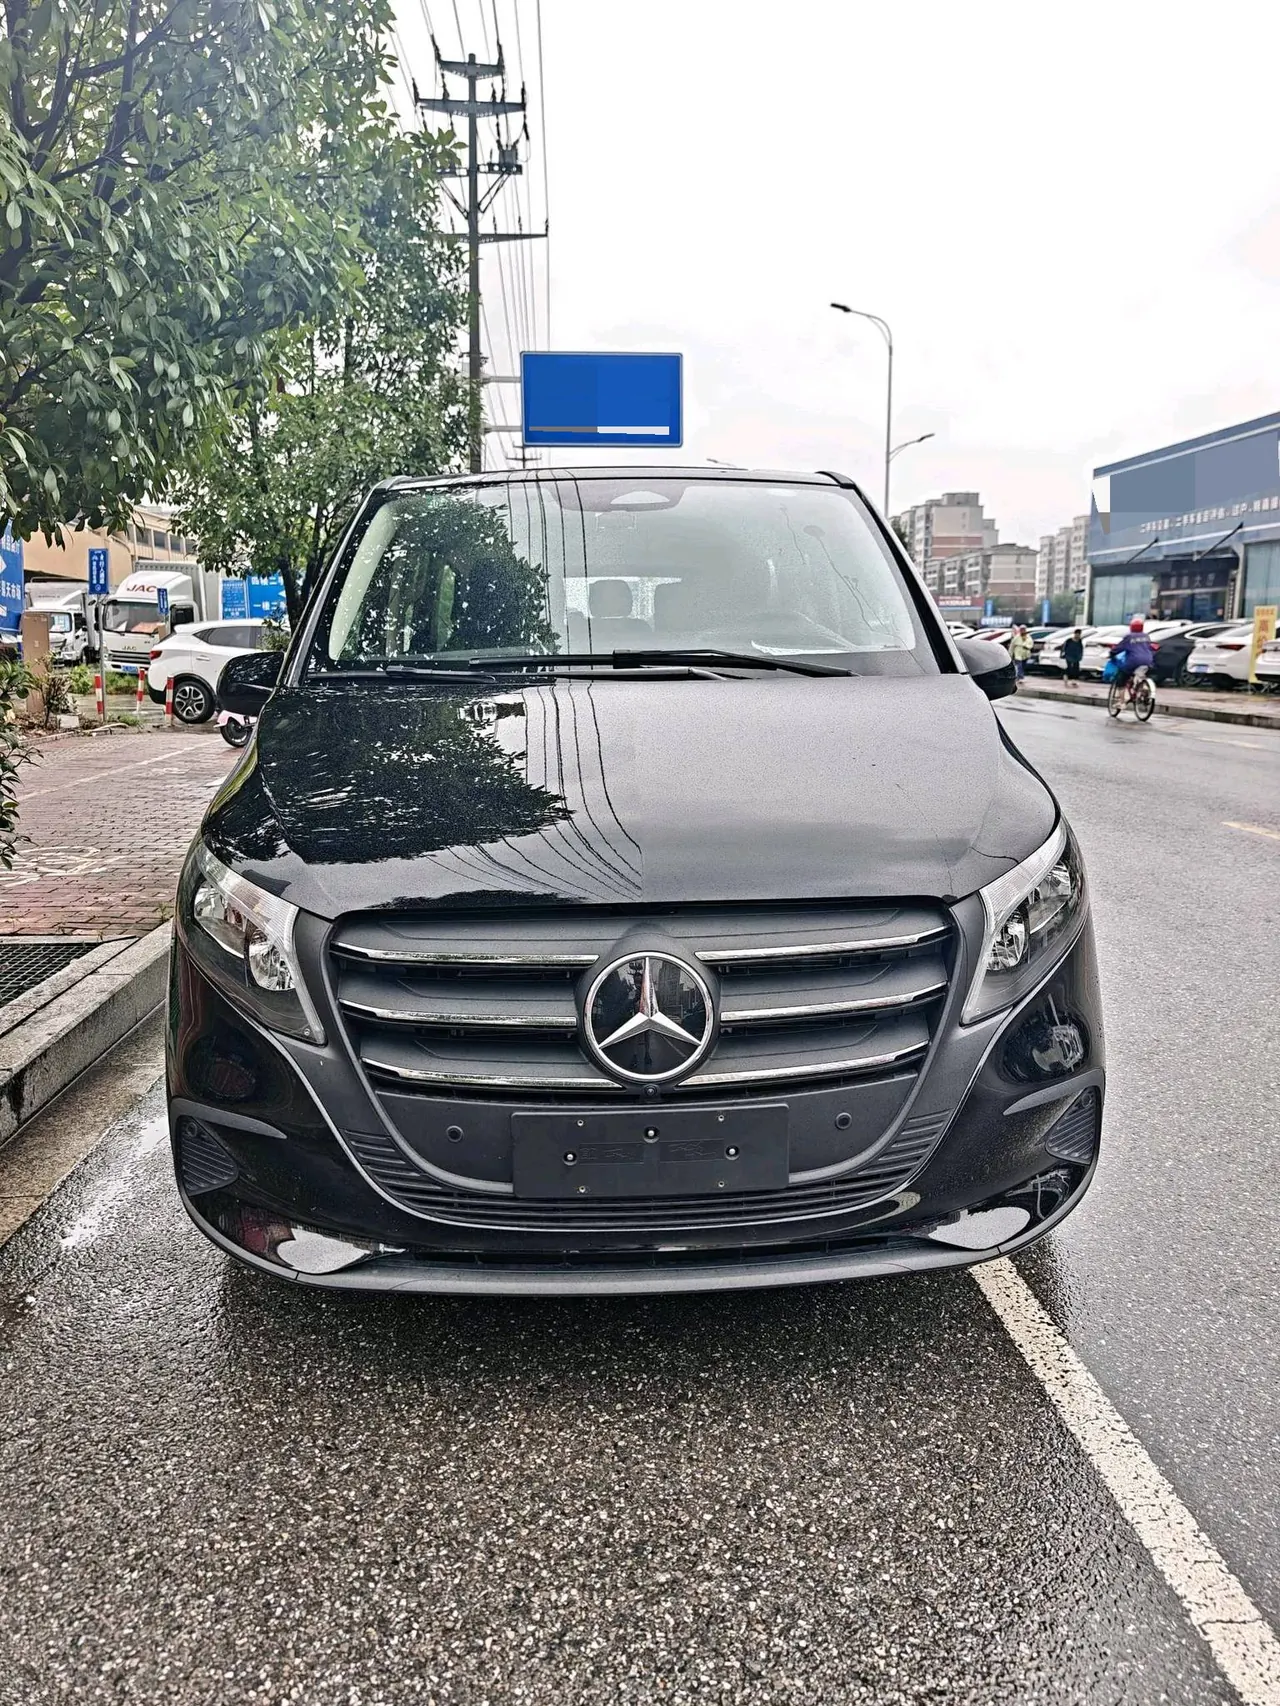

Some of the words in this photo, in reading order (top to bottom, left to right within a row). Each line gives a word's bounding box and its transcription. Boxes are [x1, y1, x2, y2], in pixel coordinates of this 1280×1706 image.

[0, 580, 21, 600] 露天市场
[127, 584, 156, 593] JAC
